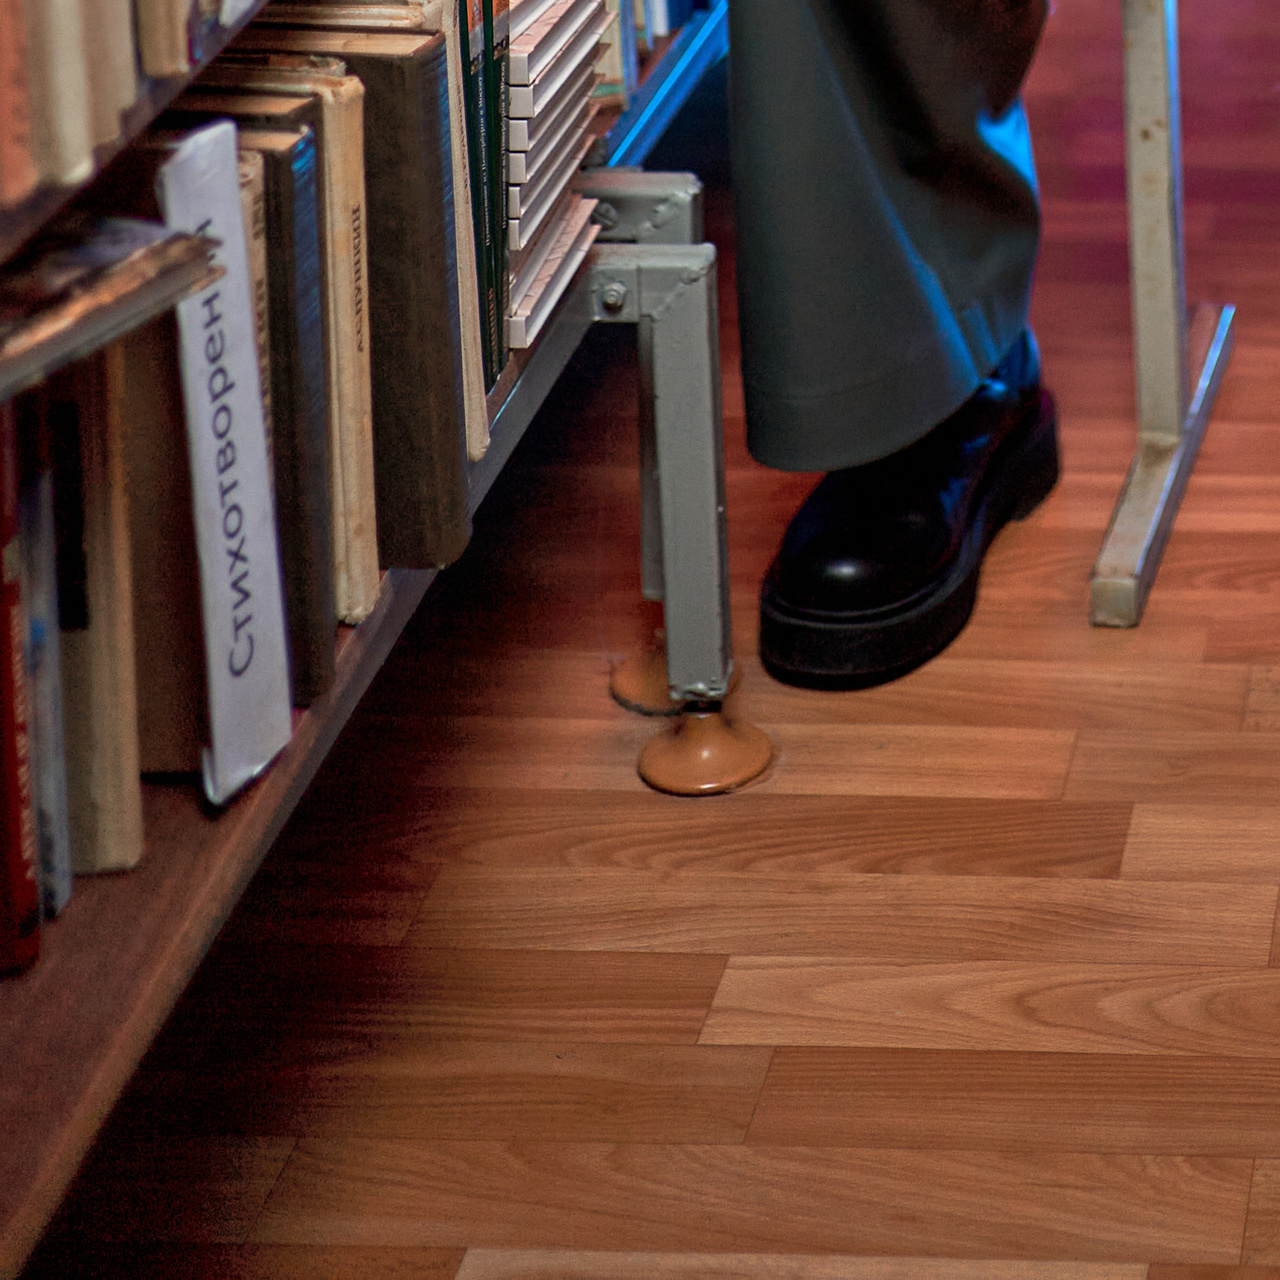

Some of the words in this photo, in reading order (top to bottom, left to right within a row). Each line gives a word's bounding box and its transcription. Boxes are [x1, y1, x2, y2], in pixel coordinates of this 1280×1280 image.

[457, 84, 468, 172] РАДИЩЕВ
[351, 203, 363, 317] ПУШКИН
[196, 219, 254, 679] Стихотворен
